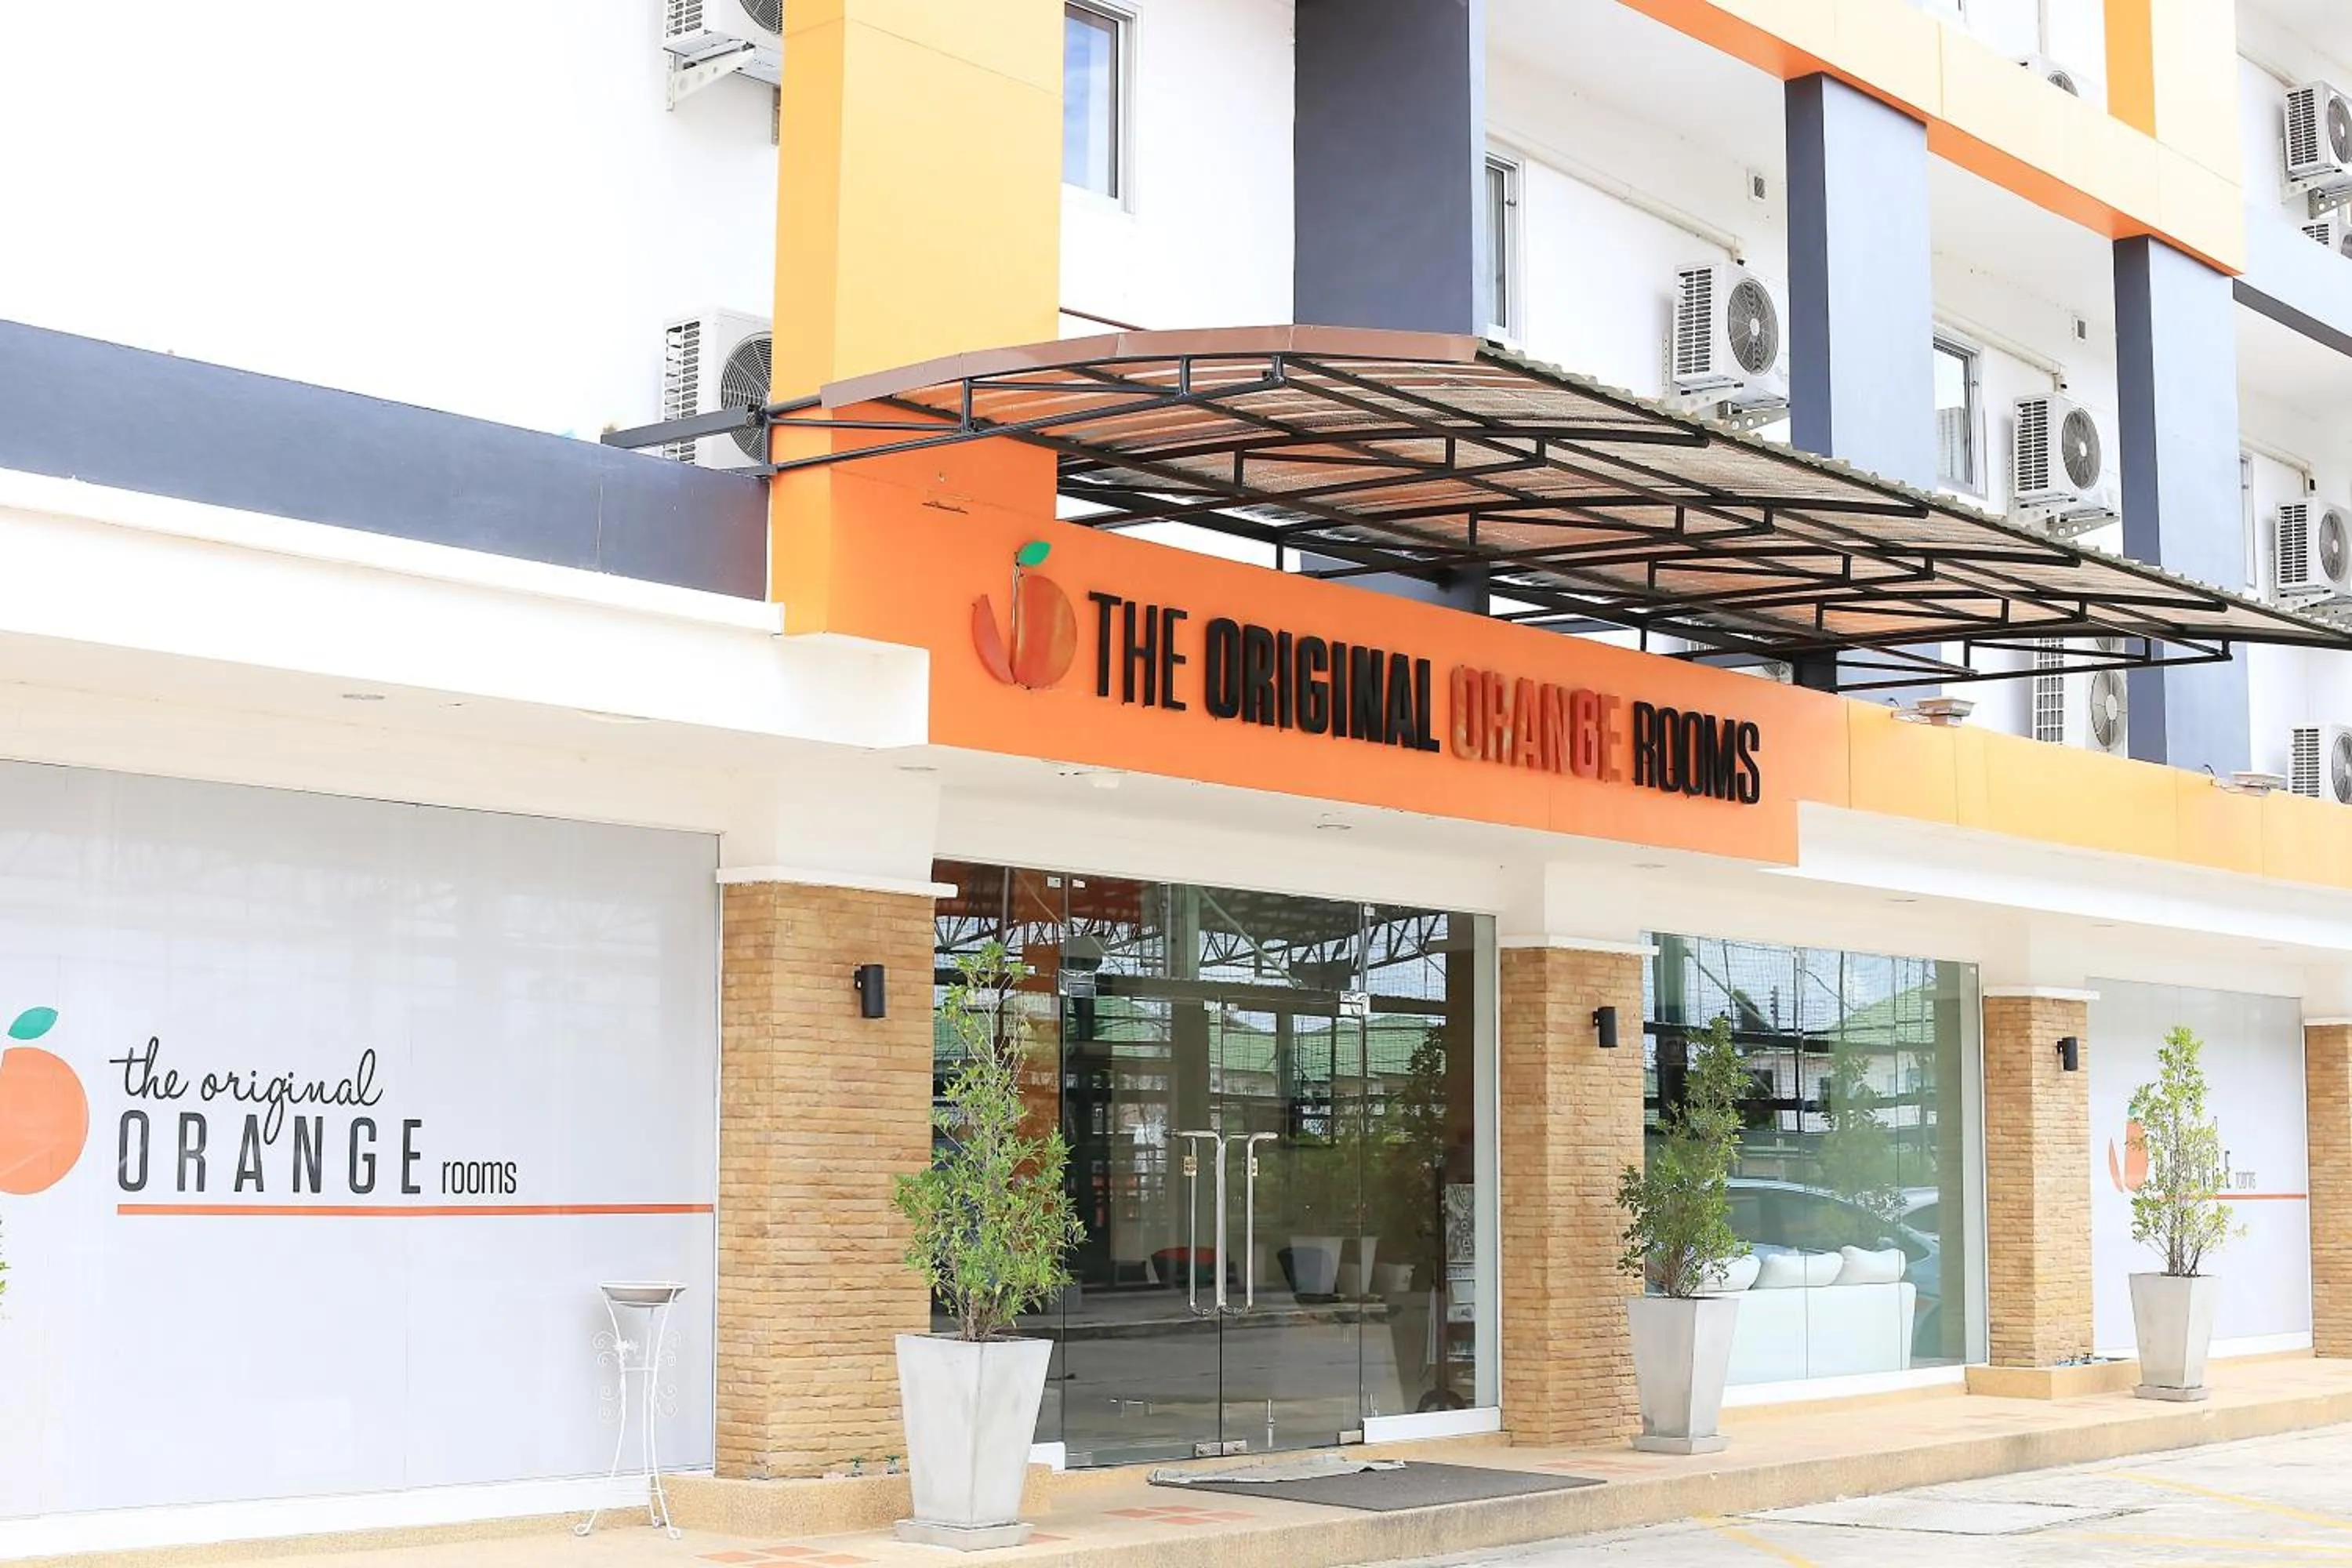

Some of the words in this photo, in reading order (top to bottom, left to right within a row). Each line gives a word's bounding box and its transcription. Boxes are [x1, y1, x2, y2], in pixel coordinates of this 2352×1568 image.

[1088, 591, 1187, 710] THE
[1205, 618, 1440, 753] ORIGINAL
[1450, 666, 1622, 782] ORANGE
[1632, 700, 1760, 804] ROOMS
[110, 1036, 189, 1098] the
[201, 1048, 383, 1145] original
[118, 1109, 422, 1194] ORANGE
[441, 1160, 517, 1194] rooms
